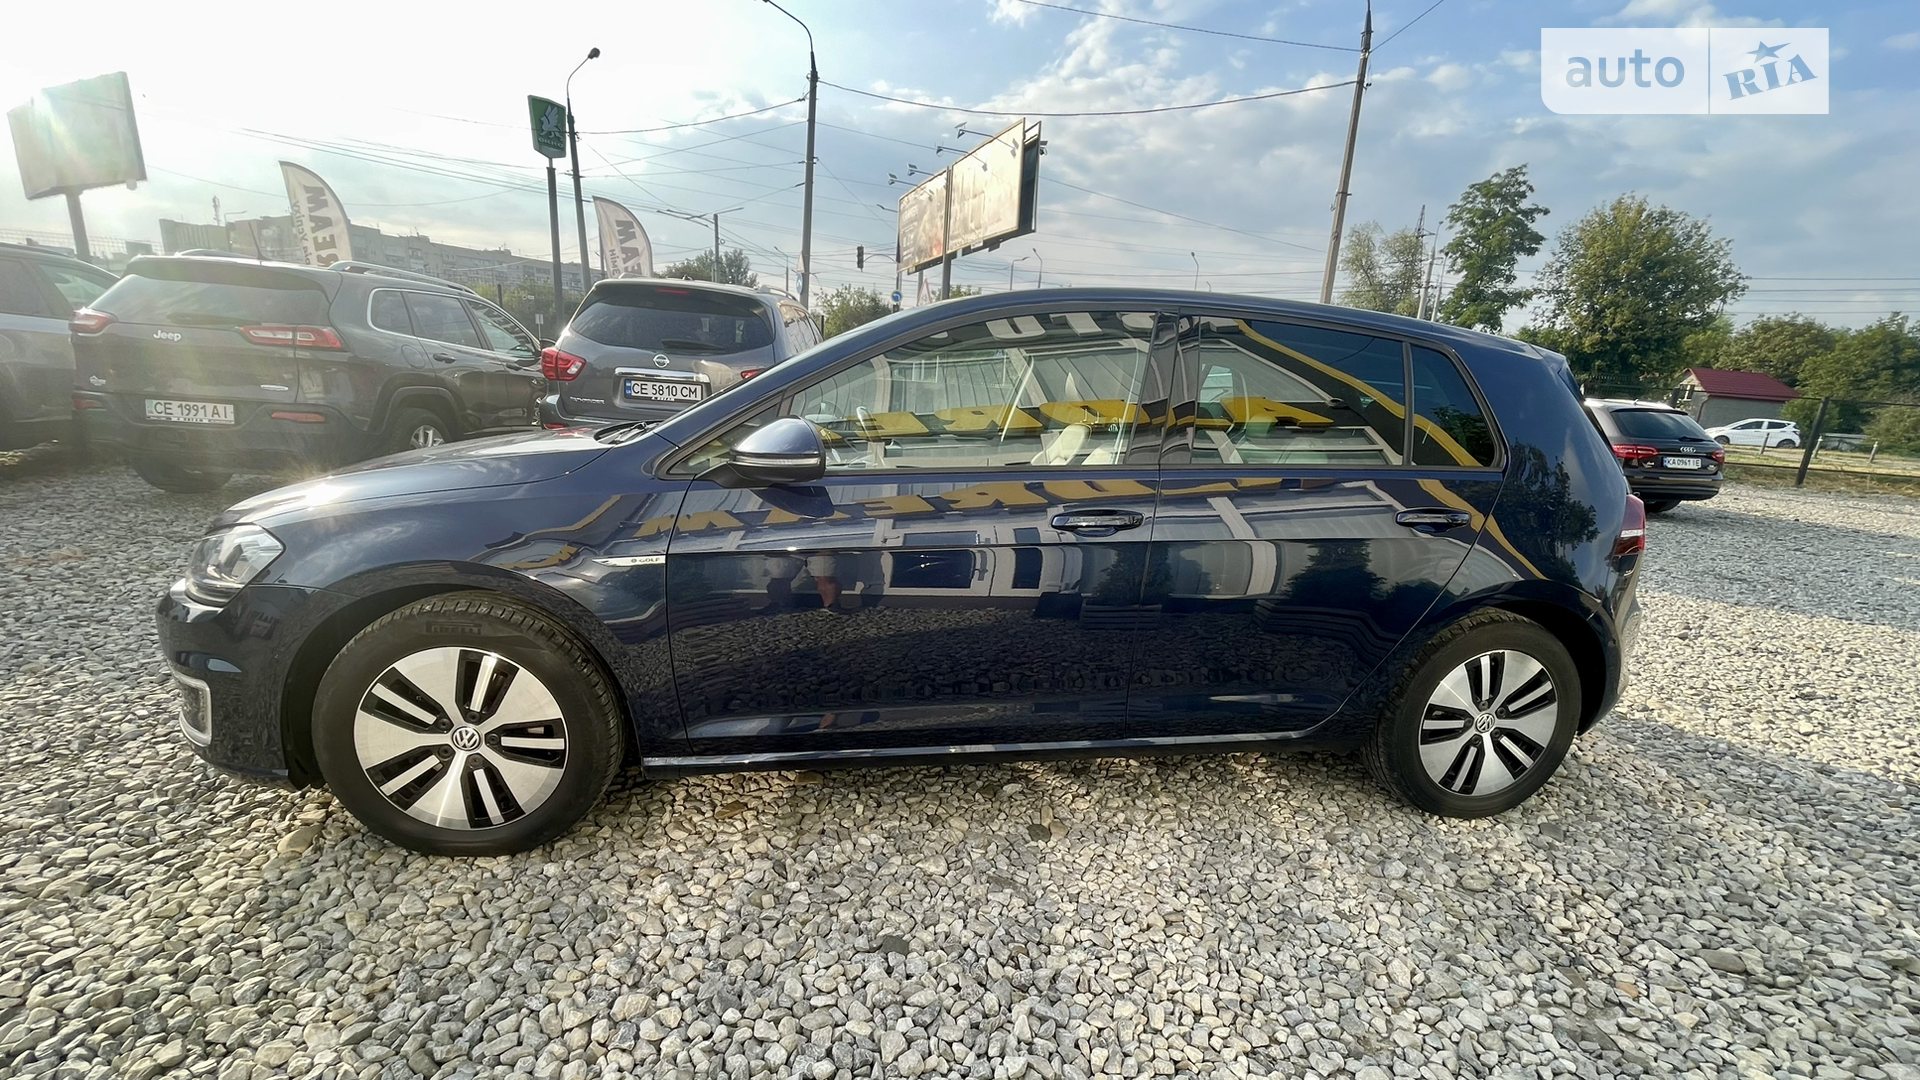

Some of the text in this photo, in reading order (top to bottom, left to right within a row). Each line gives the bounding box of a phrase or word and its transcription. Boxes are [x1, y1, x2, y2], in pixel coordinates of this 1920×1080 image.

[153, 329, 182, 342] Jeep
[632, 382, 648, 395] CE
[651, 384, 678, 397] 5810
[680, 386, 698, 398] CM
[154, 402, 173, 416] CE
[177, 403, 207, 418] 1991
[1667, 458, 1677, 466] KA
[1692, 459, 1700, 467] IE
